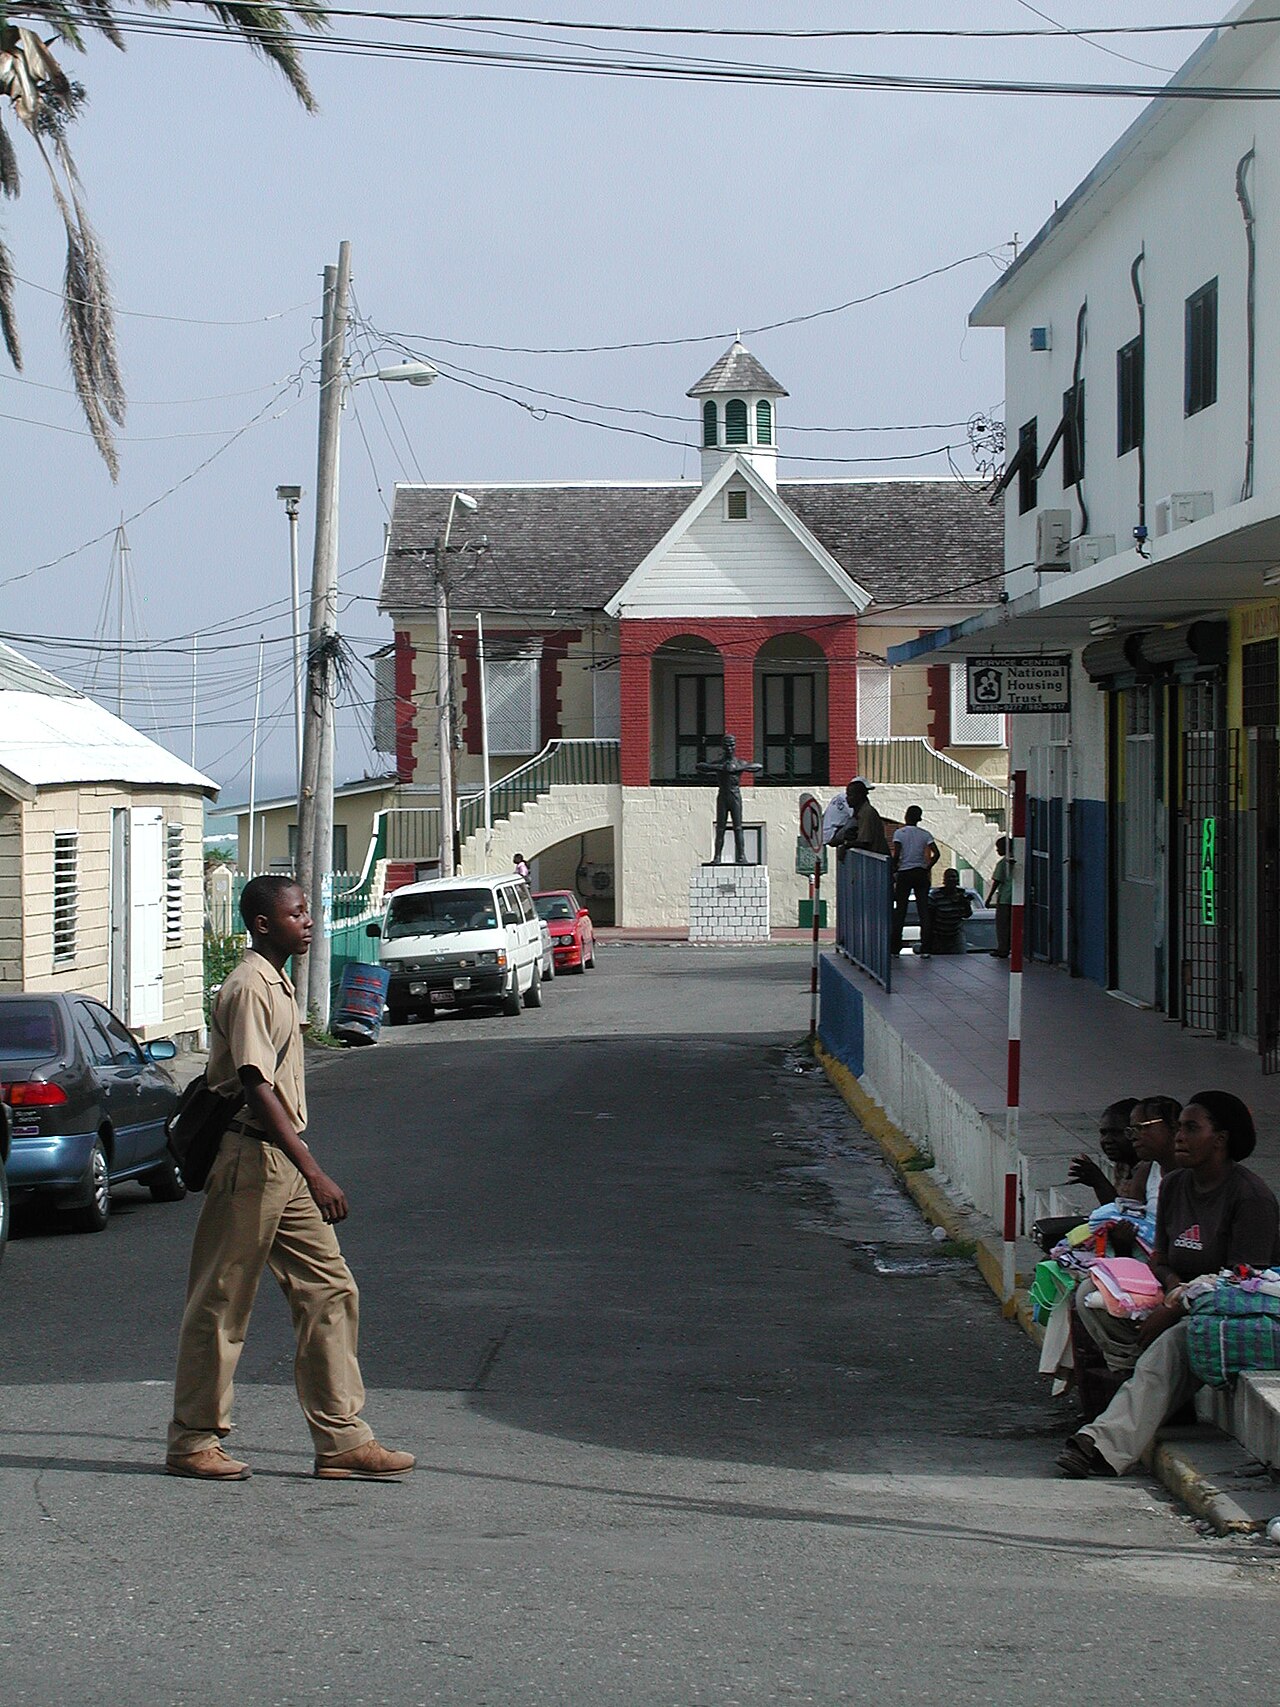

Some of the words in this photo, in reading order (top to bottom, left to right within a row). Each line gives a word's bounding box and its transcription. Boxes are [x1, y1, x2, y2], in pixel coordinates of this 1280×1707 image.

[1007, 667, 1065, 677] National
[1007, 680, 1062, 692] Housing
[1007, 693, 1042, 703] Trust
[1203, 819, 1213, 922] SALE
[1174, 1239, 1203, 1250] adidas
